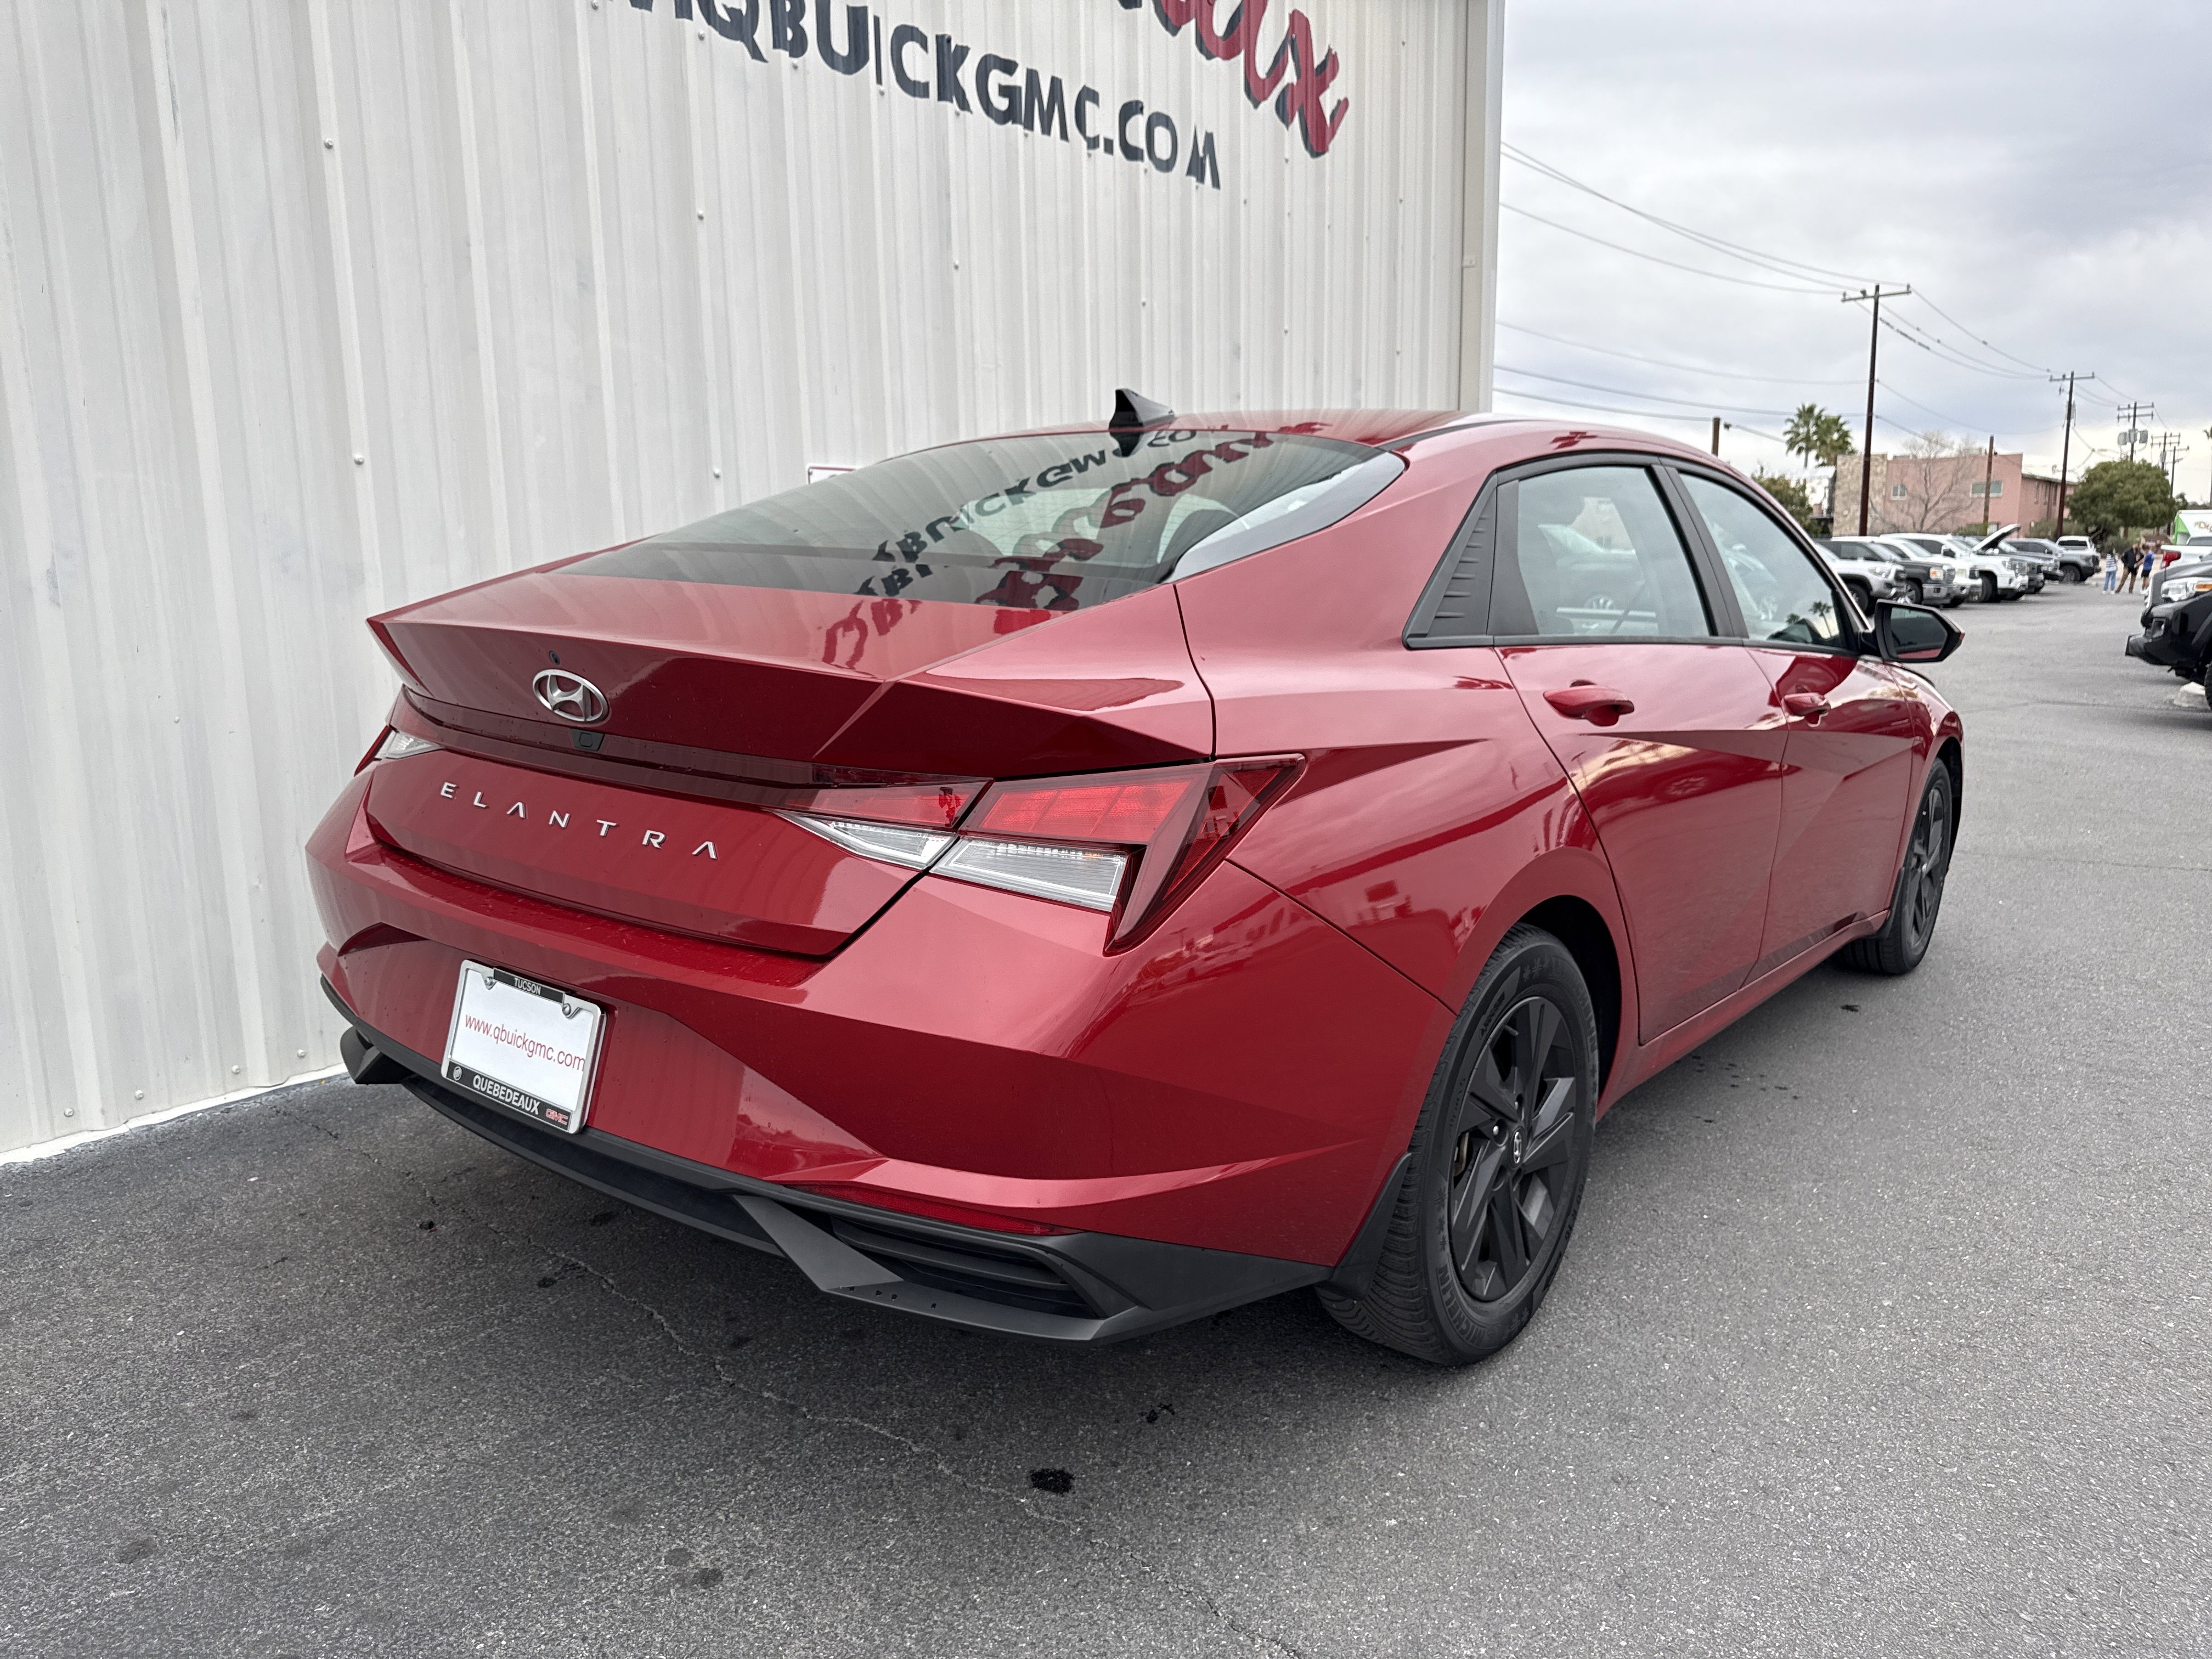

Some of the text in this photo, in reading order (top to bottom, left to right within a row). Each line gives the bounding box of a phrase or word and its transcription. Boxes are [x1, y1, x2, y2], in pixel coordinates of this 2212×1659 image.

[439, 781, 718, 860] ELANTRA
[514, 977, 541, 996] TUCSON
[465, 1014, 585, 1072] www.qbuickgmc.com
[472, 1075, 568, 1125] QUEBEDEAUX GMC
